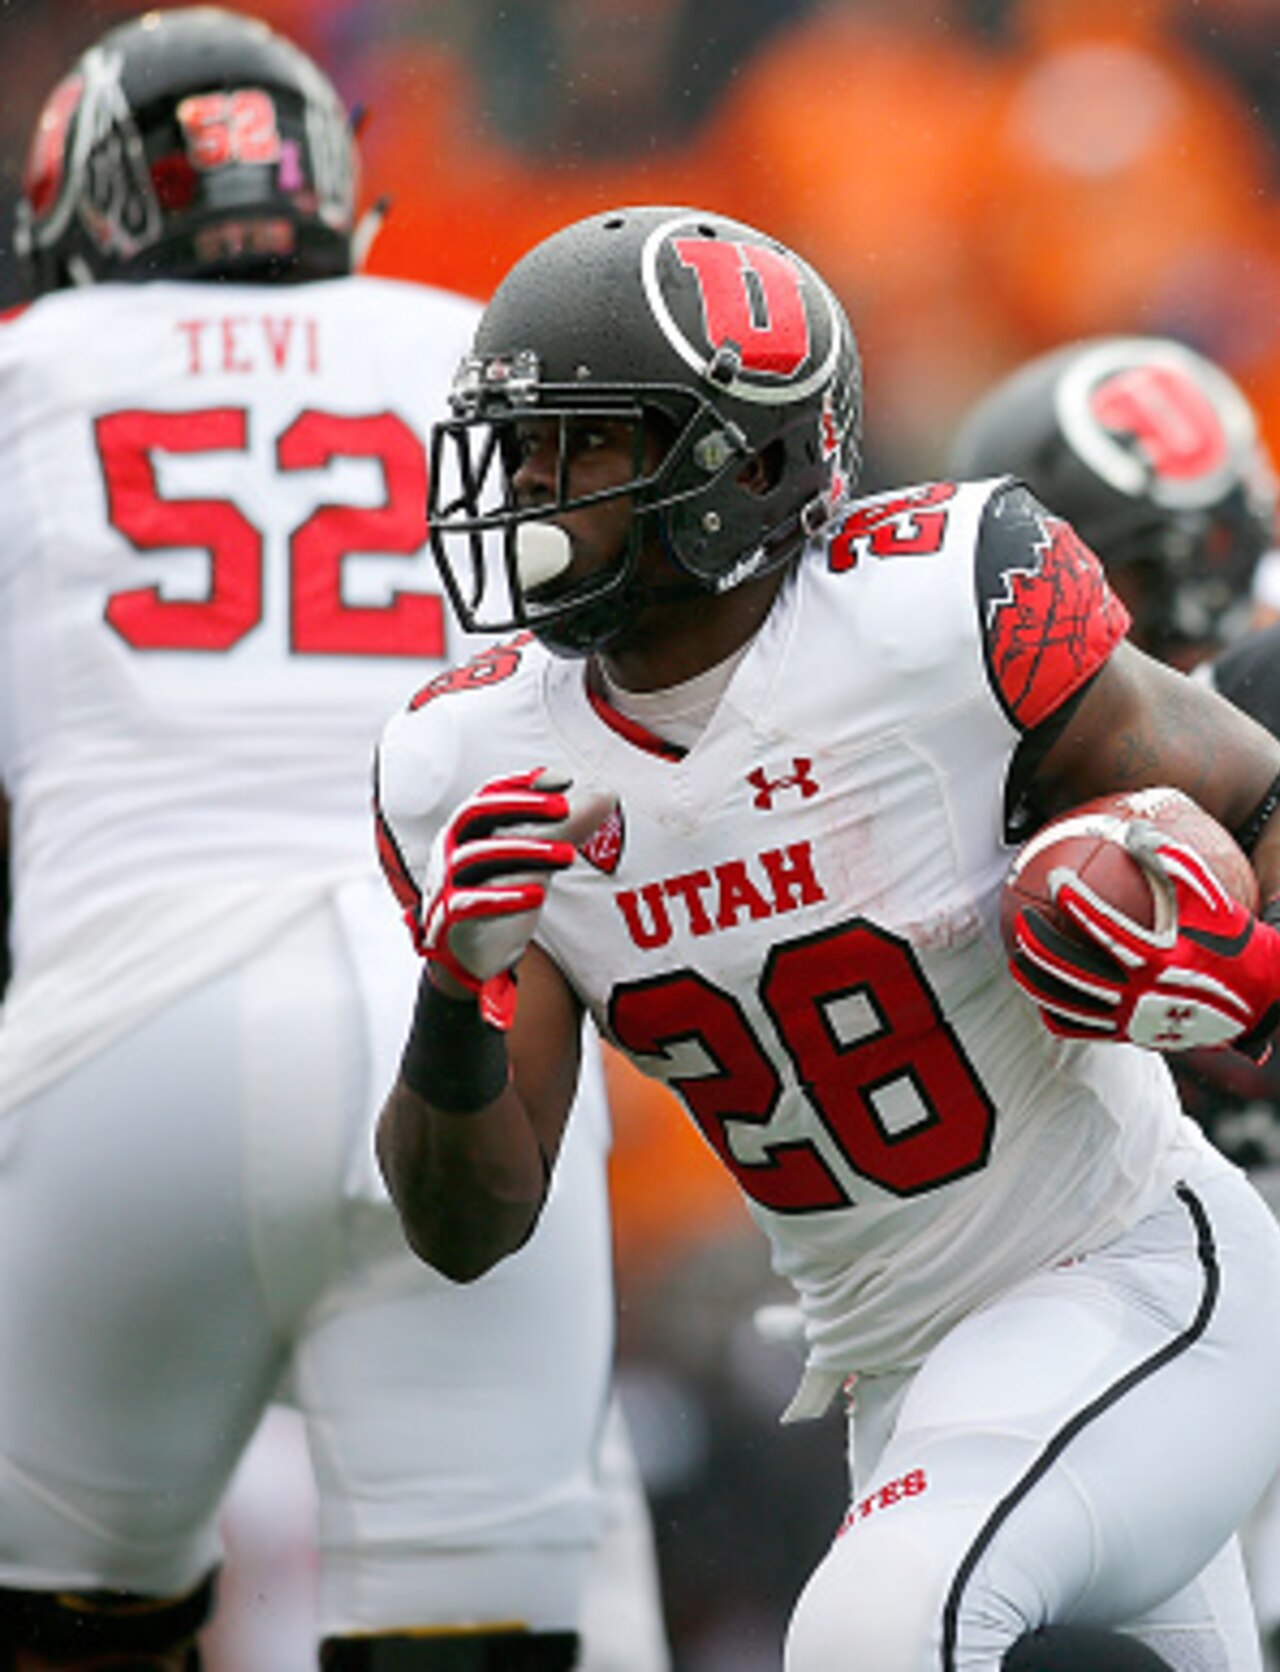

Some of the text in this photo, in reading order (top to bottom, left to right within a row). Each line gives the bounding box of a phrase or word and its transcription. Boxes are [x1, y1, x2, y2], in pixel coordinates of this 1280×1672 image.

[177, 87, 280, 169] 52
[174, 316, 320, 376] TEVI
[670, 234, 811, 379] U
[93, 406, 447, 657] 52
[614, 840, 827, 951] UTAH
[606, 917, 996, 1213] 28
